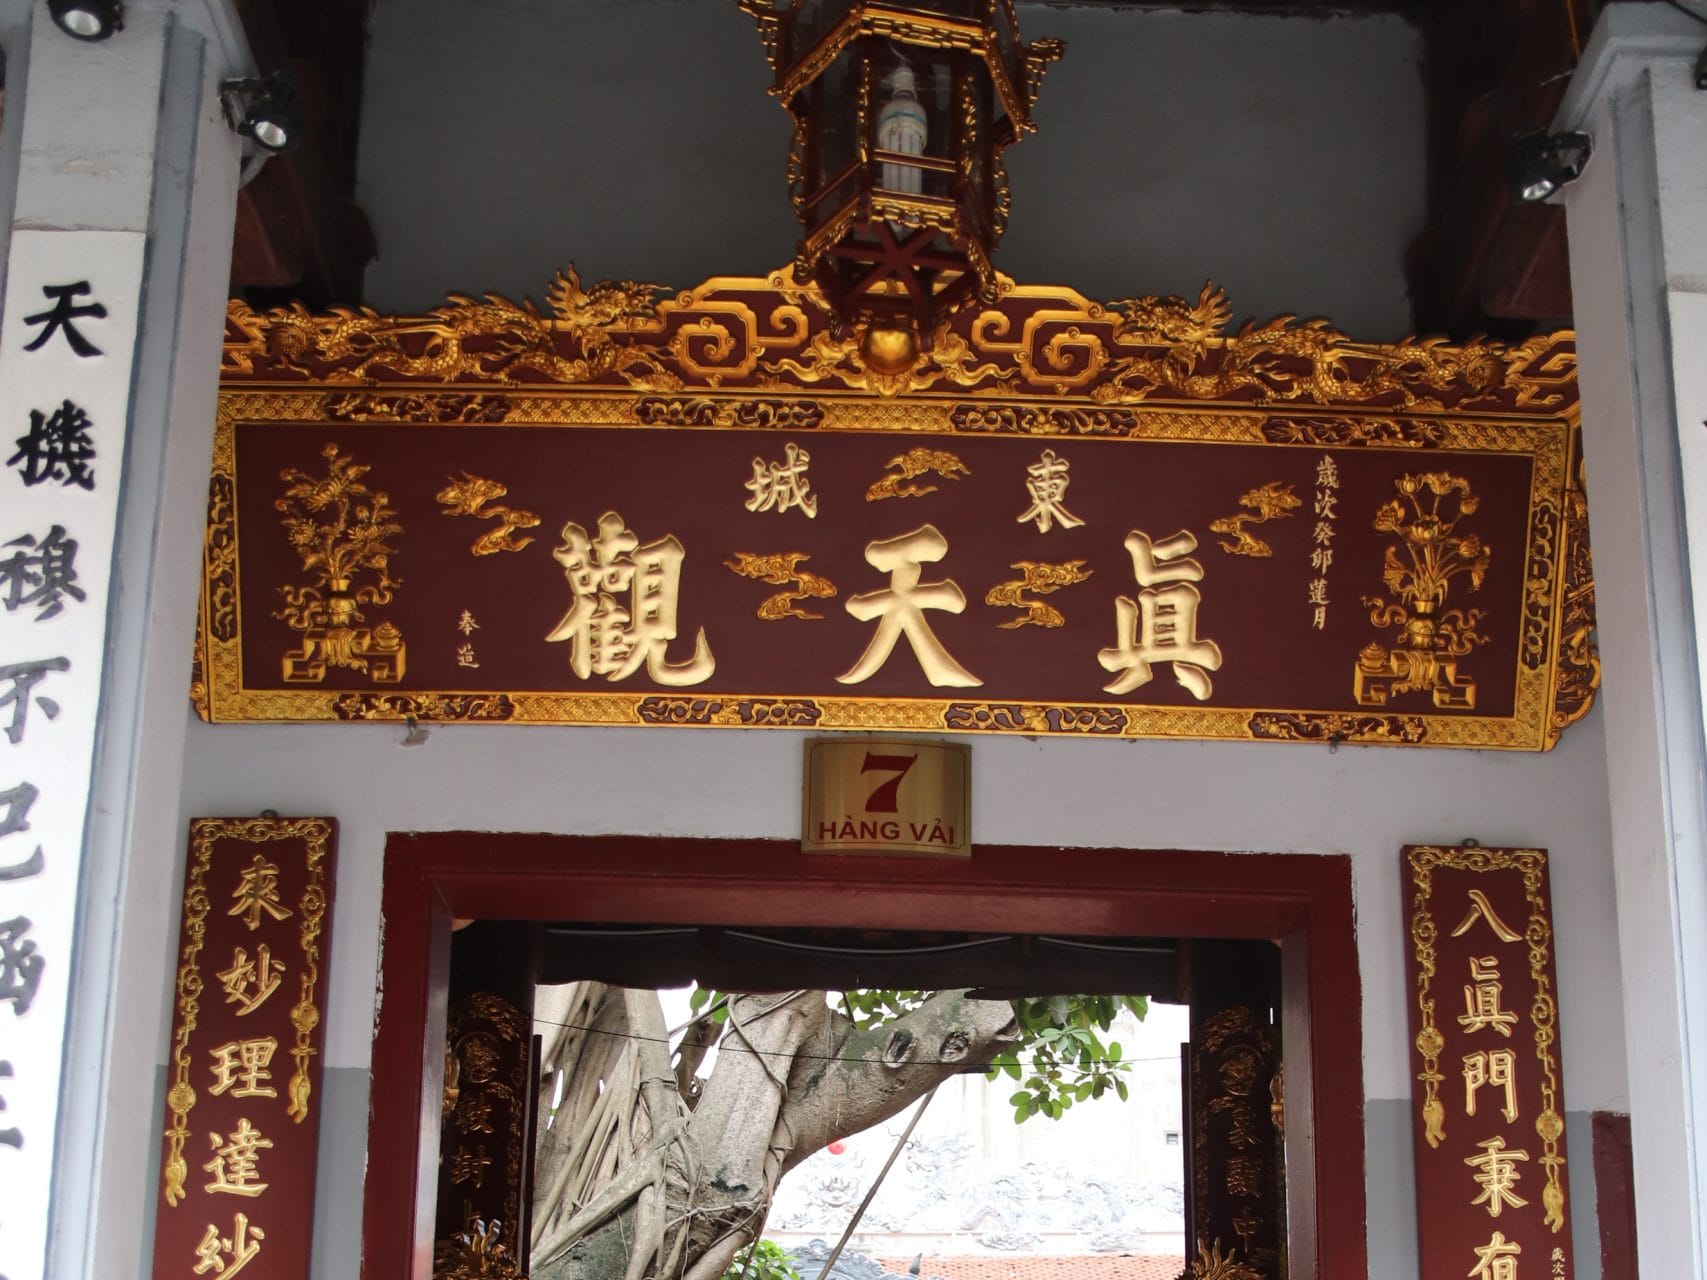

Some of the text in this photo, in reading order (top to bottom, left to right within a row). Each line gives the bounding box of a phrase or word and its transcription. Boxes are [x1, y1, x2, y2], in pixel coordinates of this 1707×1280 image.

[860, 751, 918, 813] 7
[819, 814, 955, 845] HÀNG VẢI
